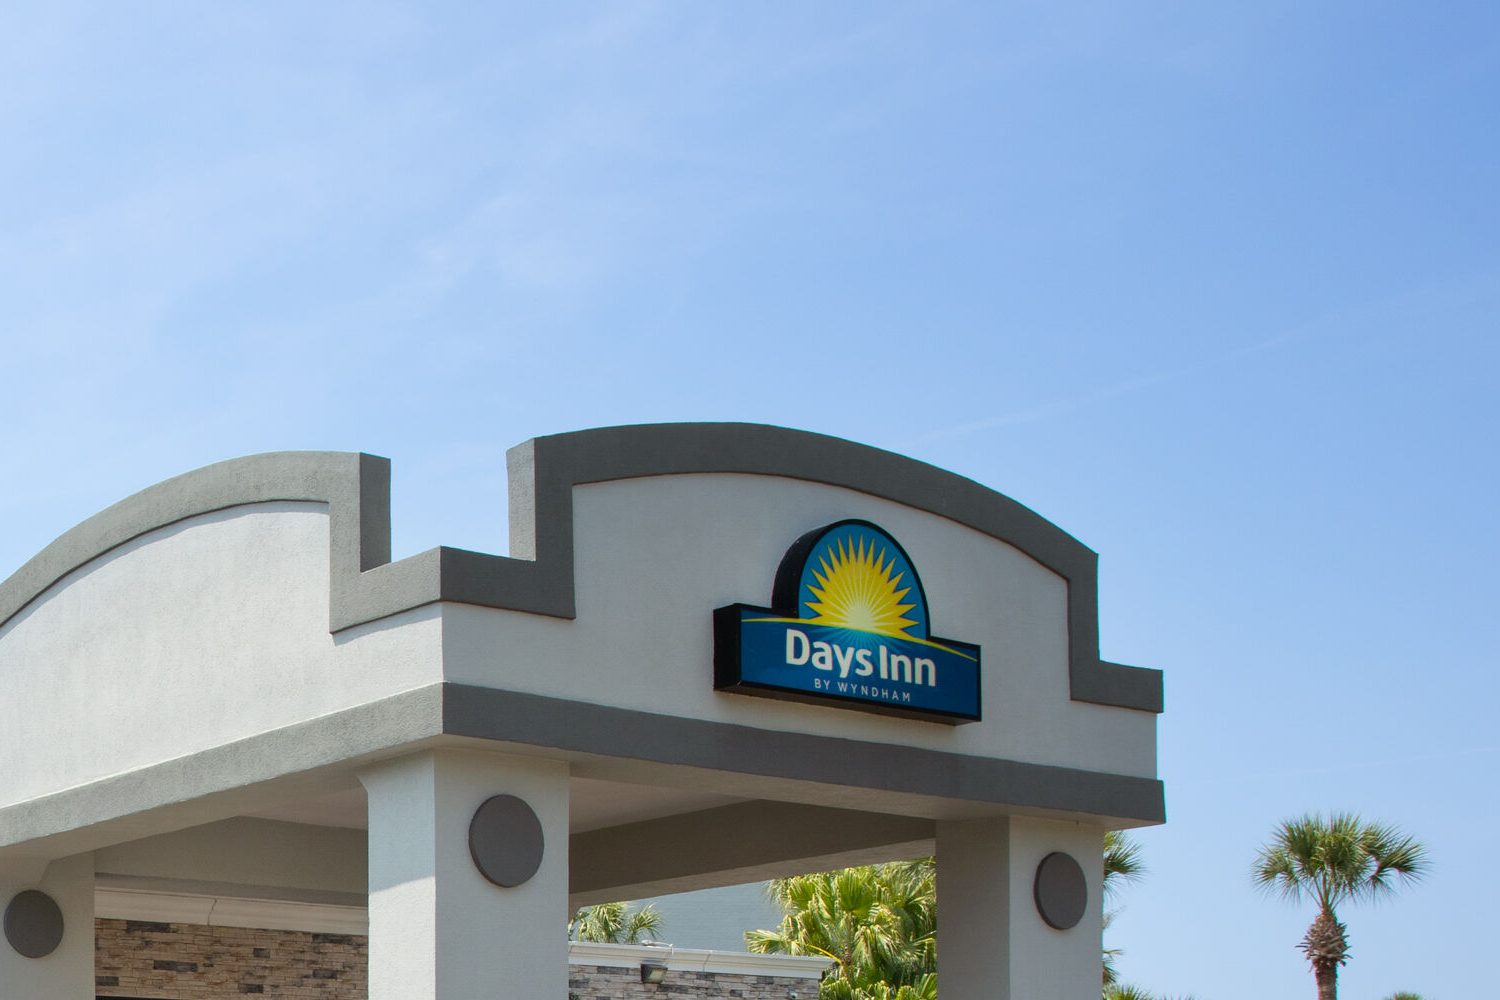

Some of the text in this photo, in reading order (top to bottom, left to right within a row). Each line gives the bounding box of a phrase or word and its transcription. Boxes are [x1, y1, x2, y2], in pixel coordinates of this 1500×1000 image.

[785, 628, 936, 687] Days Inn
[814, 678, 911, 703] BY WYNDHAM
